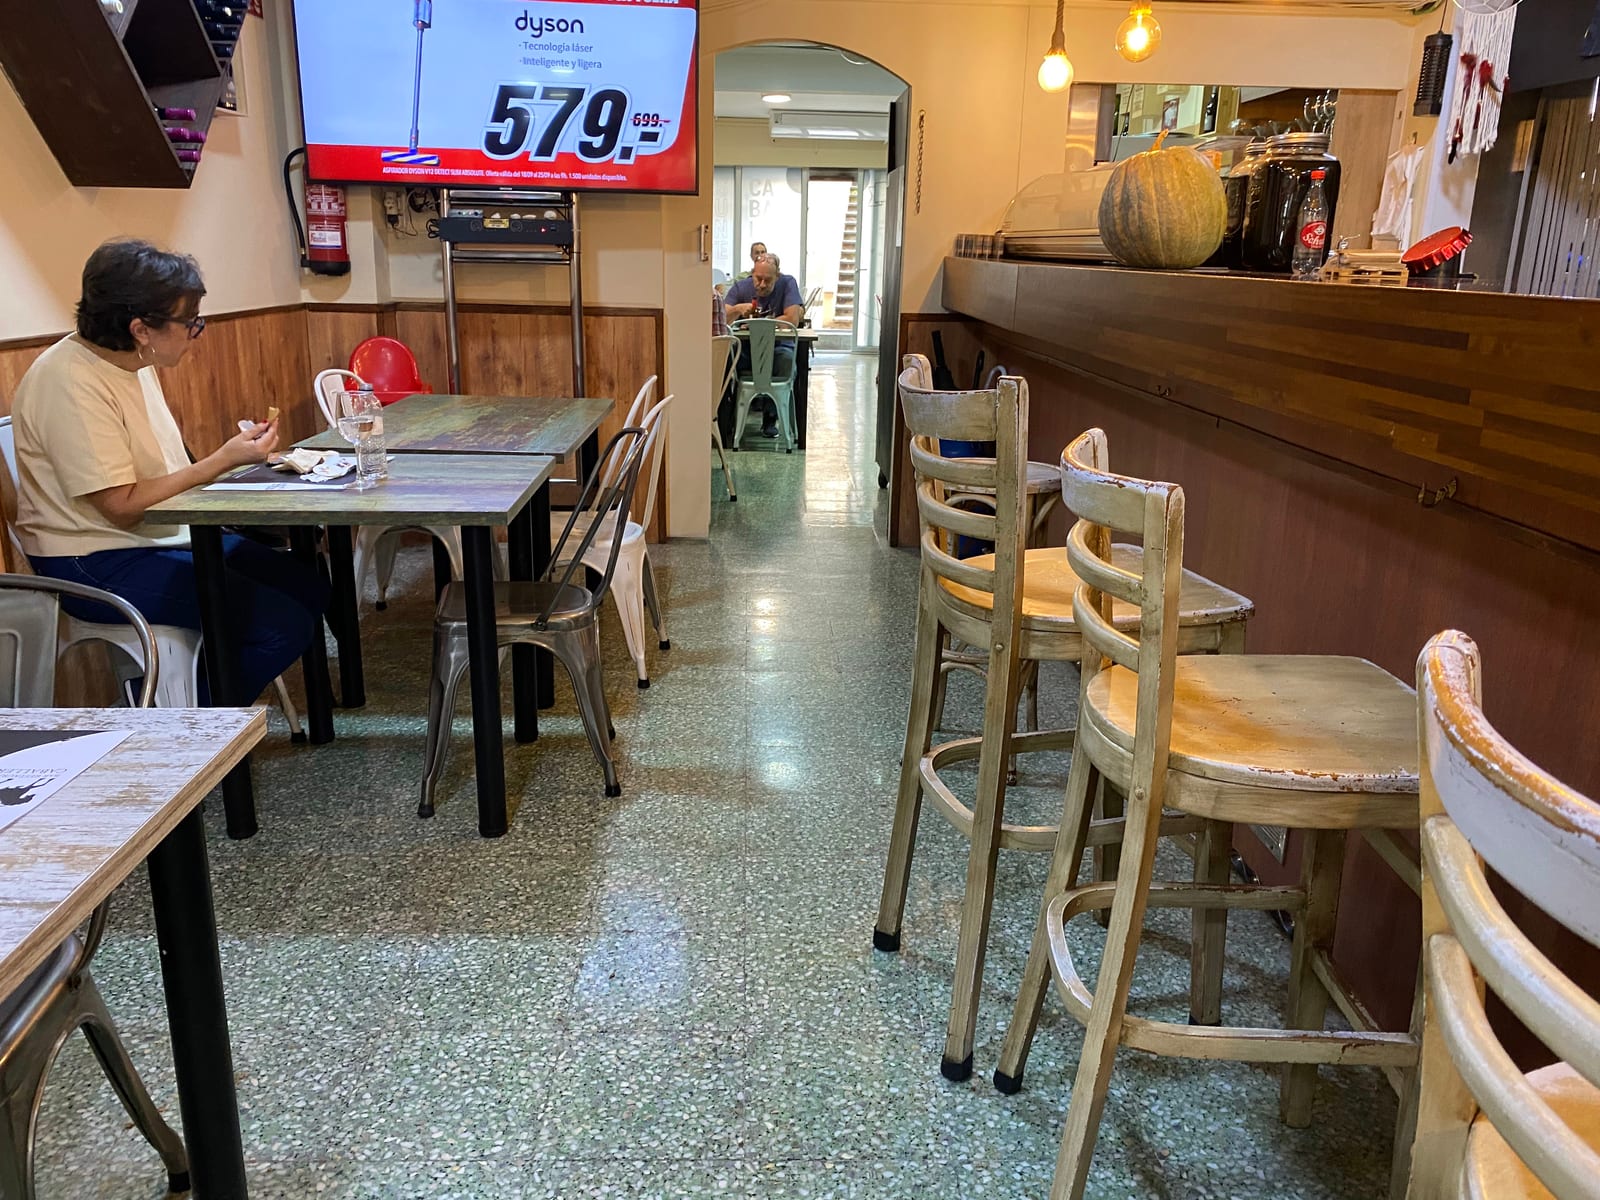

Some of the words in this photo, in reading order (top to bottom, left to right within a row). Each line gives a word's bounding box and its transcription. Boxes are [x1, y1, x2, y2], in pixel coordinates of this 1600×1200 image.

[515, 9, 584, 38] dyson
[523, 41, 570, 54] Tecnología
[572, 42, 593, 53] láser
[523, 56, 570, 69] Inteligente
[571, 60, 577, 69] y
[578, 58, 602, 70] ligera
